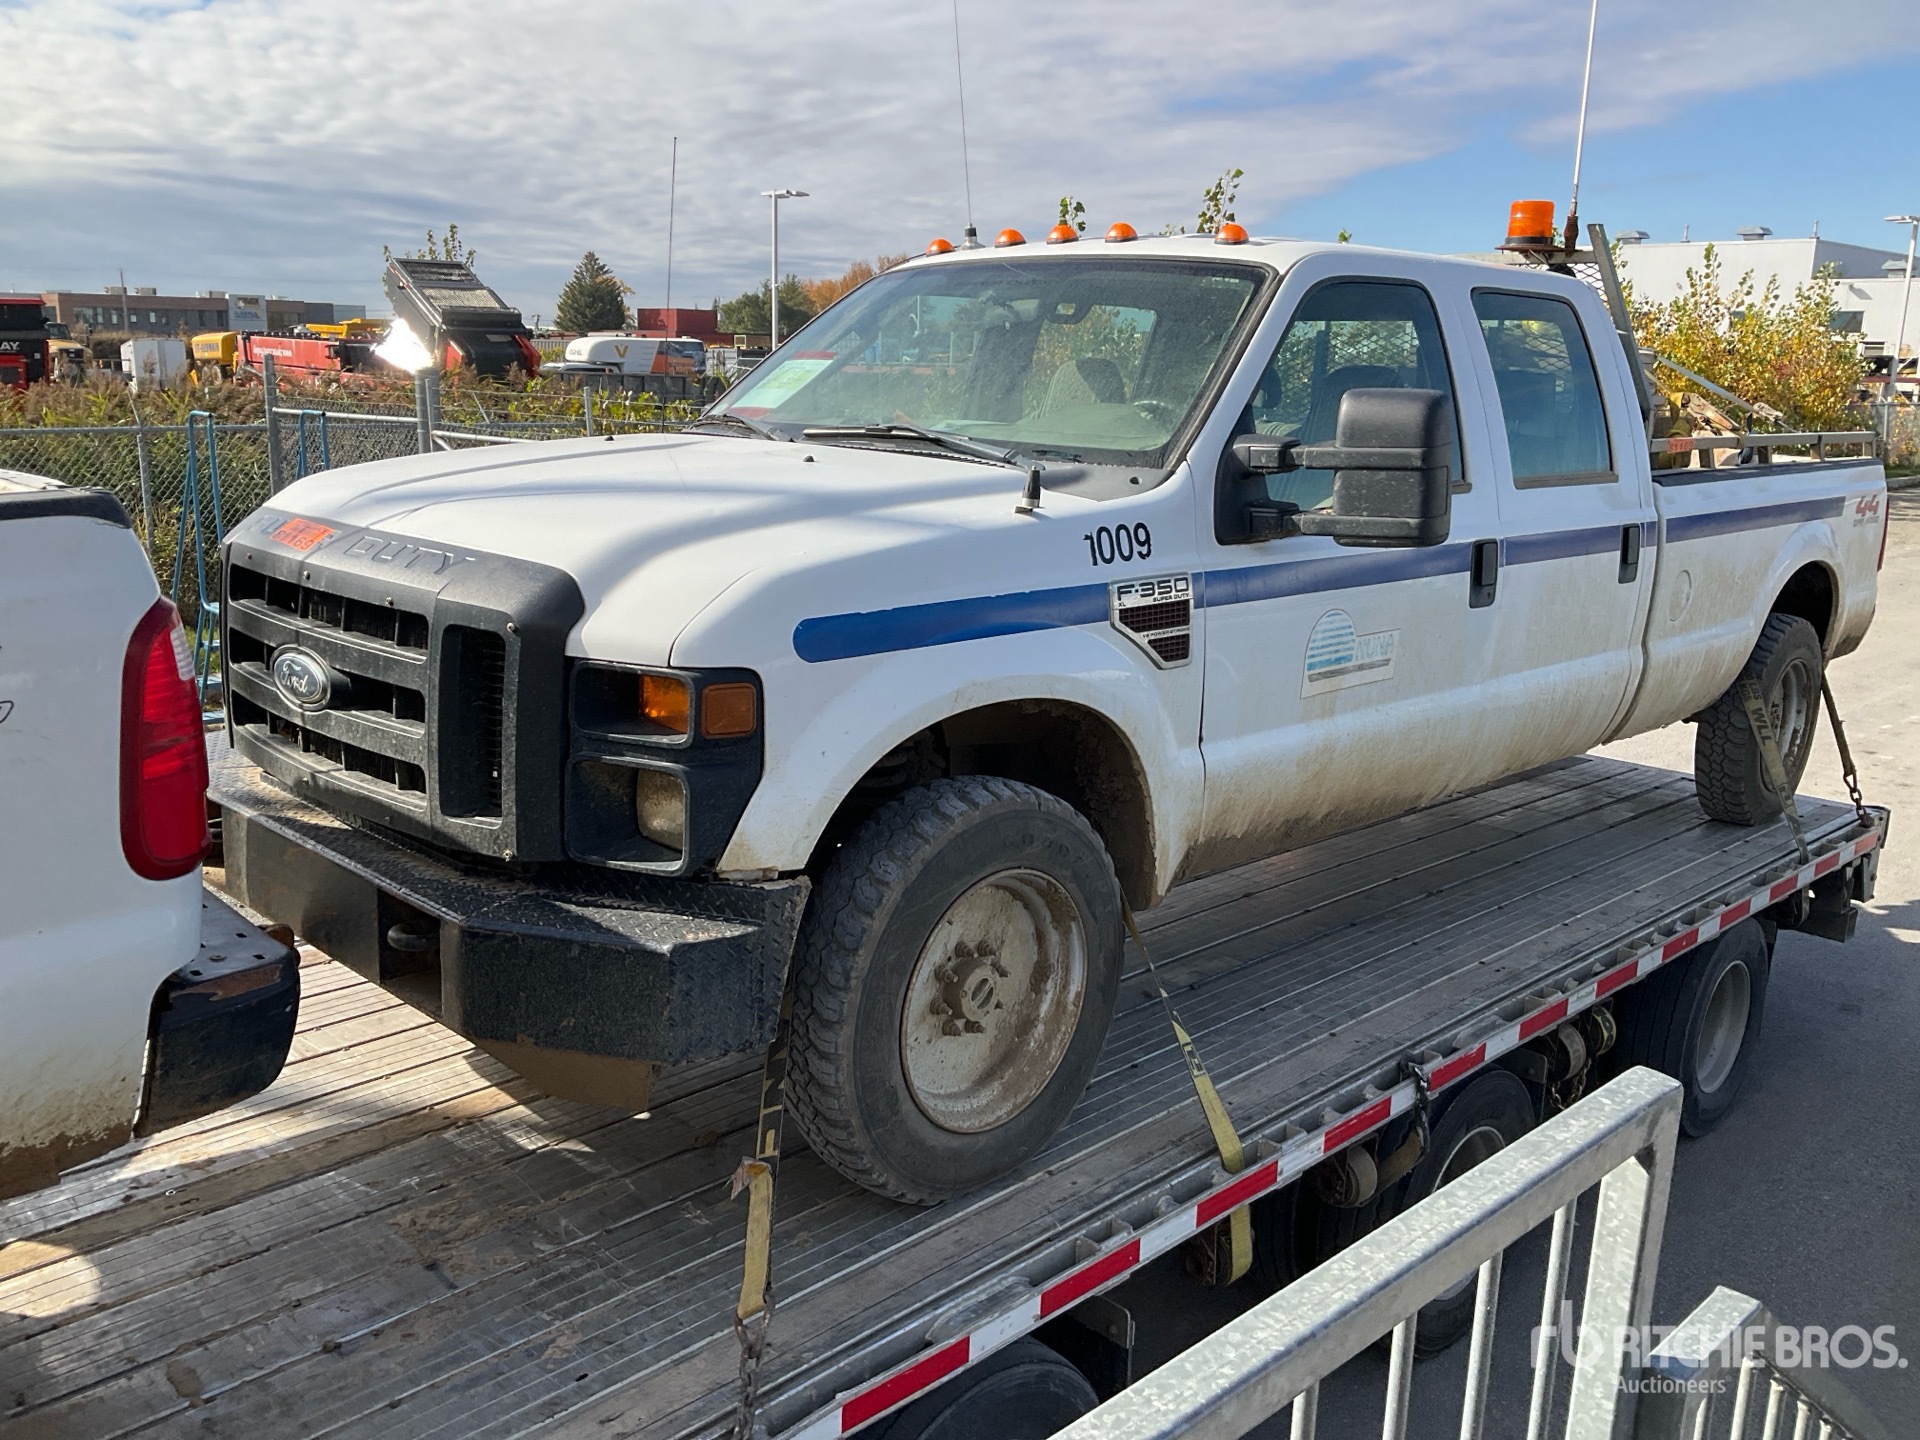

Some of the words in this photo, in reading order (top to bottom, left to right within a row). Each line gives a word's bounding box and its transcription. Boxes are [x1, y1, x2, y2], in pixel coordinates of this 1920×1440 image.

[344, 536, 455, 576] DUTY
[1082, 522, 1152, 567] 1009
[1173, 593, 1190, 601] DUTY
[280, 660, 310, 693] Ford
[1751, 707, 1772, 746] WLL
